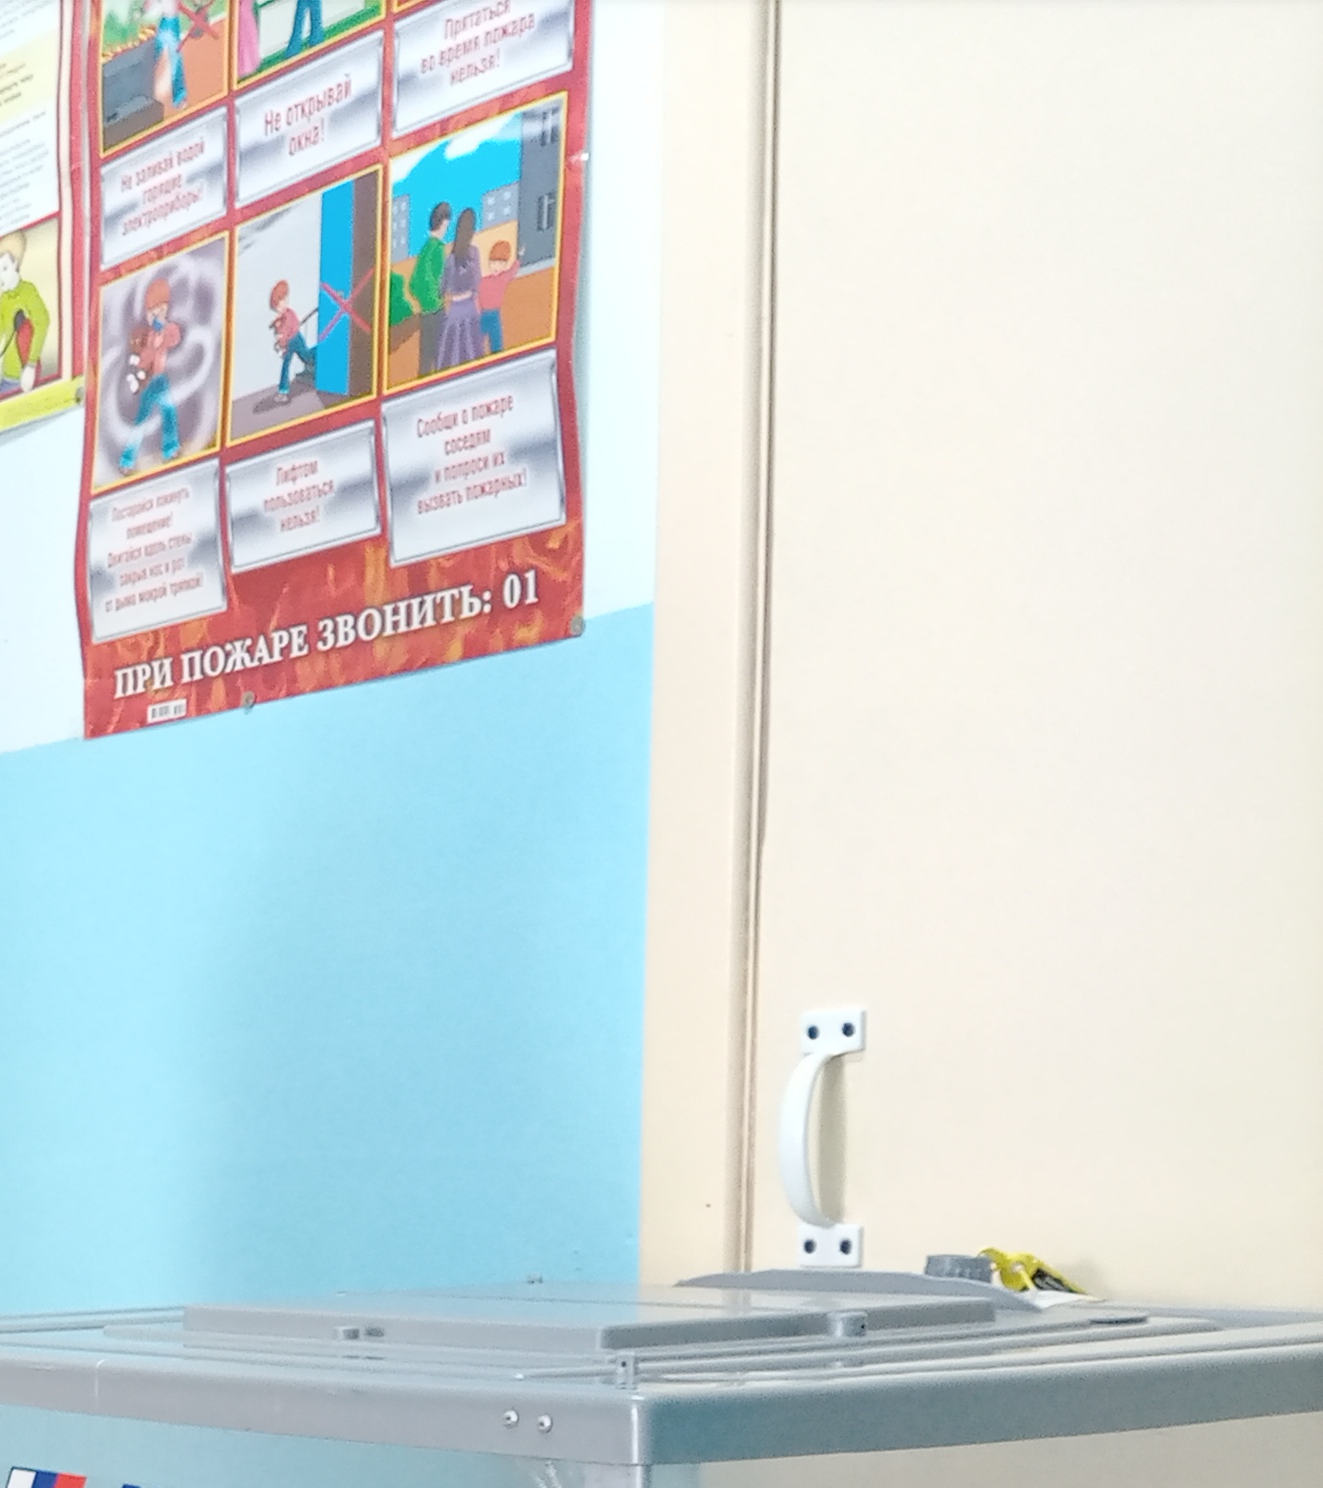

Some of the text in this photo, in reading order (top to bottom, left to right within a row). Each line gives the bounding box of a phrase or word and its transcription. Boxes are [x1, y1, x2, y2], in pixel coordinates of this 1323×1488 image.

[444, 1, 511, 40] Прятаться
[420, 13, 535, 74] во время пожара
[451, 49, 501, 86] нельзя!
[265, 73, 352, 136] Не открывай
[289, 118, 325, 155] окна!
[417, 395, 514, 438] Сообщи о пожаре
[444, 429, 491, 456] соседям
[276, 460, 318, 486] Лифтом
[417, 468, 527, 514] вызвать пожарных!
[434, 470, 441, 484] и
[280, 504, 321, 532] нельзя!
[113, 570, 540, 699] ПРИ ПОЖАРЕ ЗВОНИТЬ: 01
